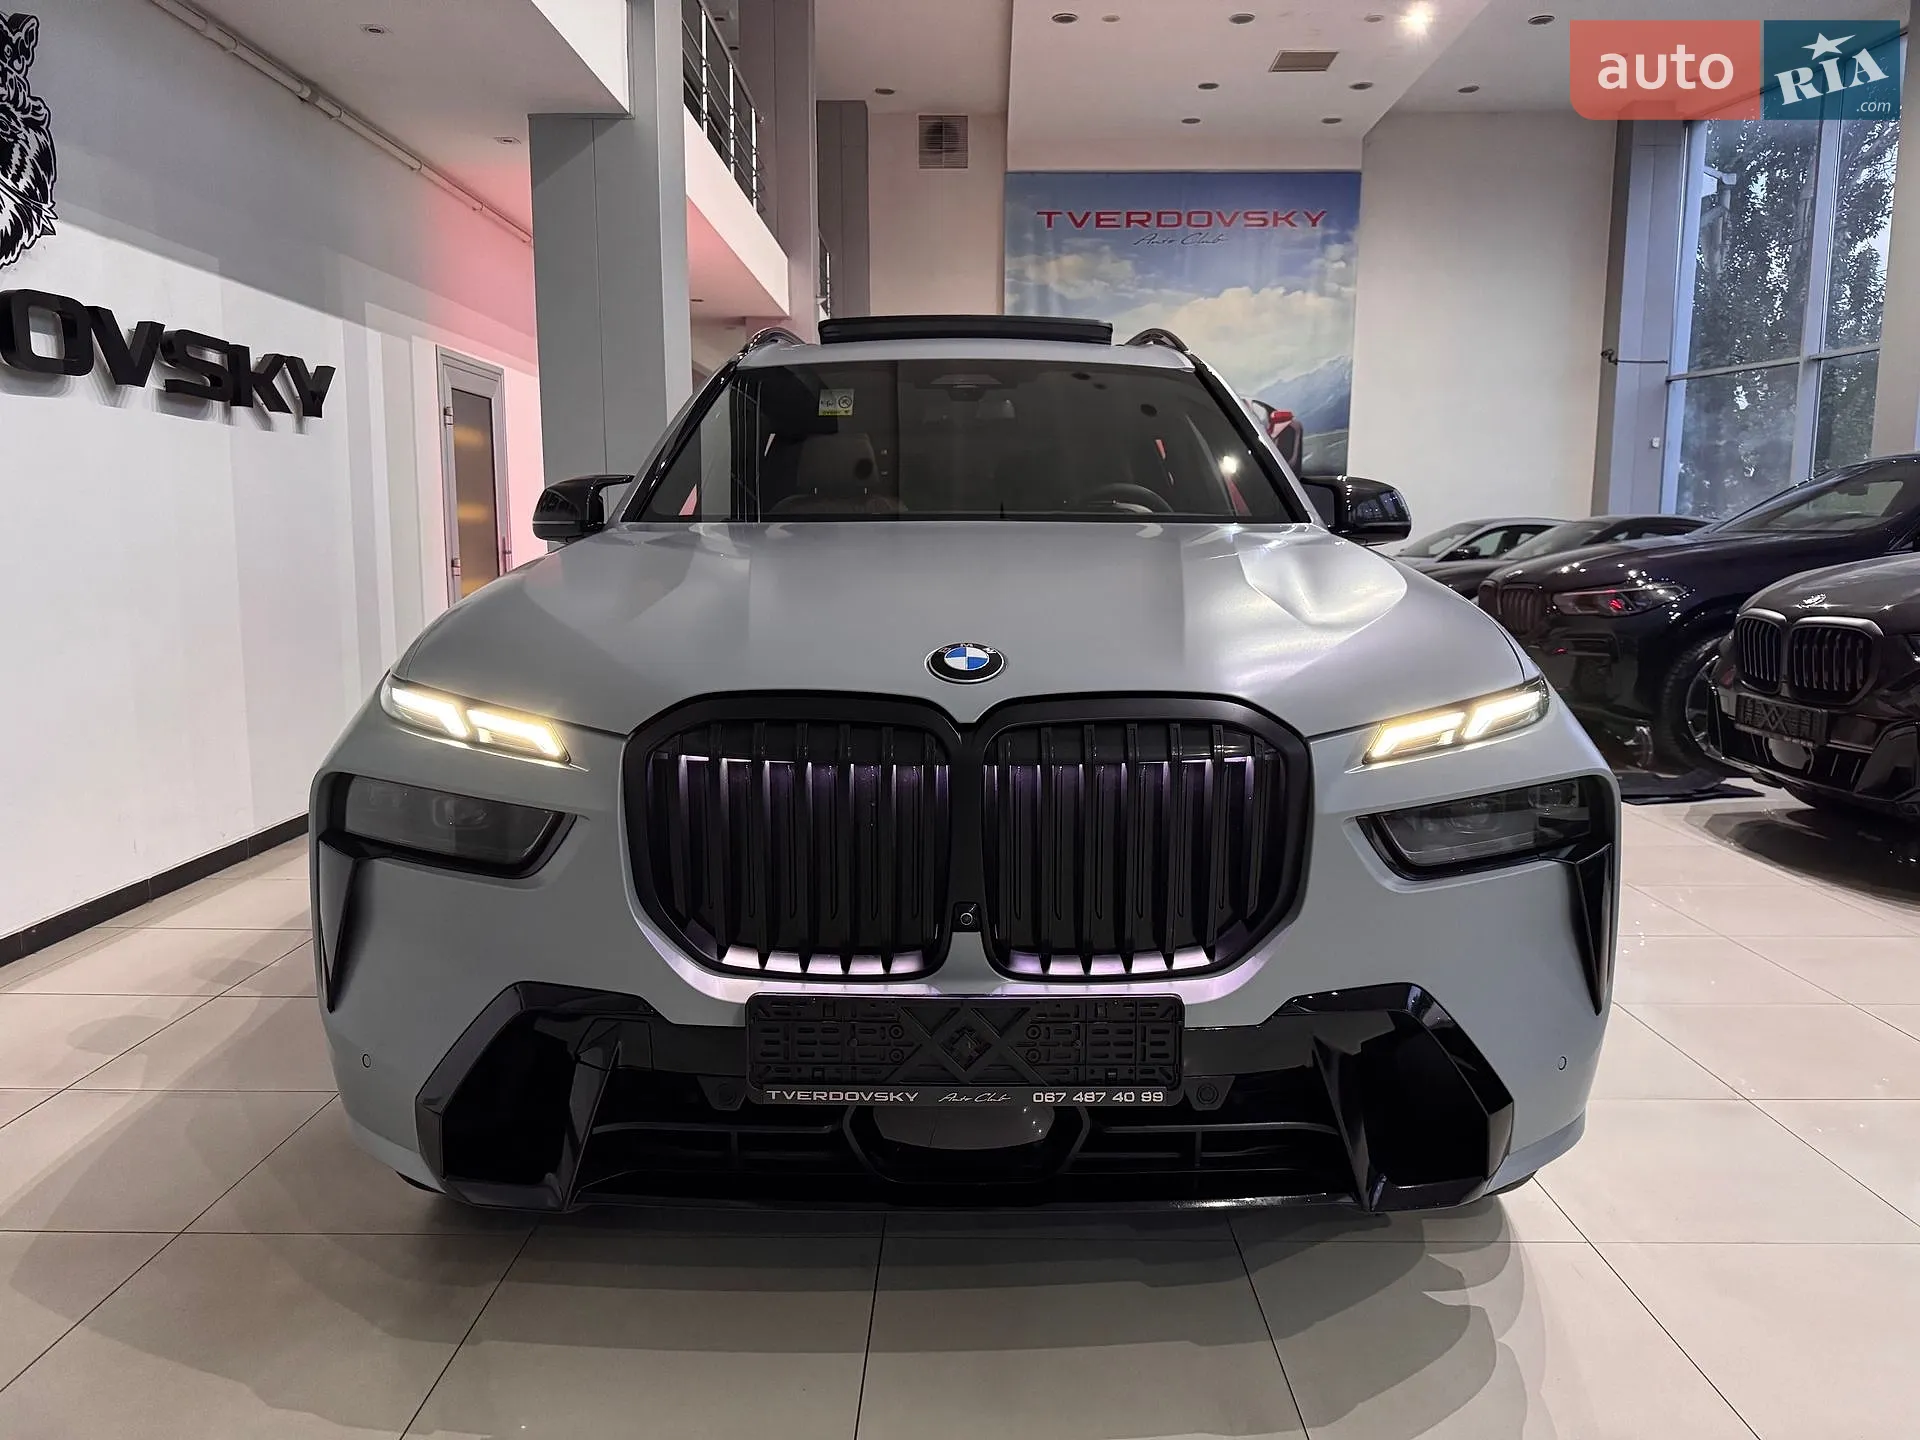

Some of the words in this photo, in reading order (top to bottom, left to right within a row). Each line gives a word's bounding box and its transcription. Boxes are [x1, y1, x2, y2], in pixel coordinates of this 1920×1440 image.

[1036, 210, 1327, 229] TVERDOVSKY
[0, 288, 337, 418] OVSKY
[766, 1090, 919, 1102] TVERDOVSKY
[1032, 1092, 1066, 1103] 067
[1073, 1092, 1106, 1103] 487
[1112, 1092, 1135, 1103] 40
[1141, 1092, 1163, 1103] 99
